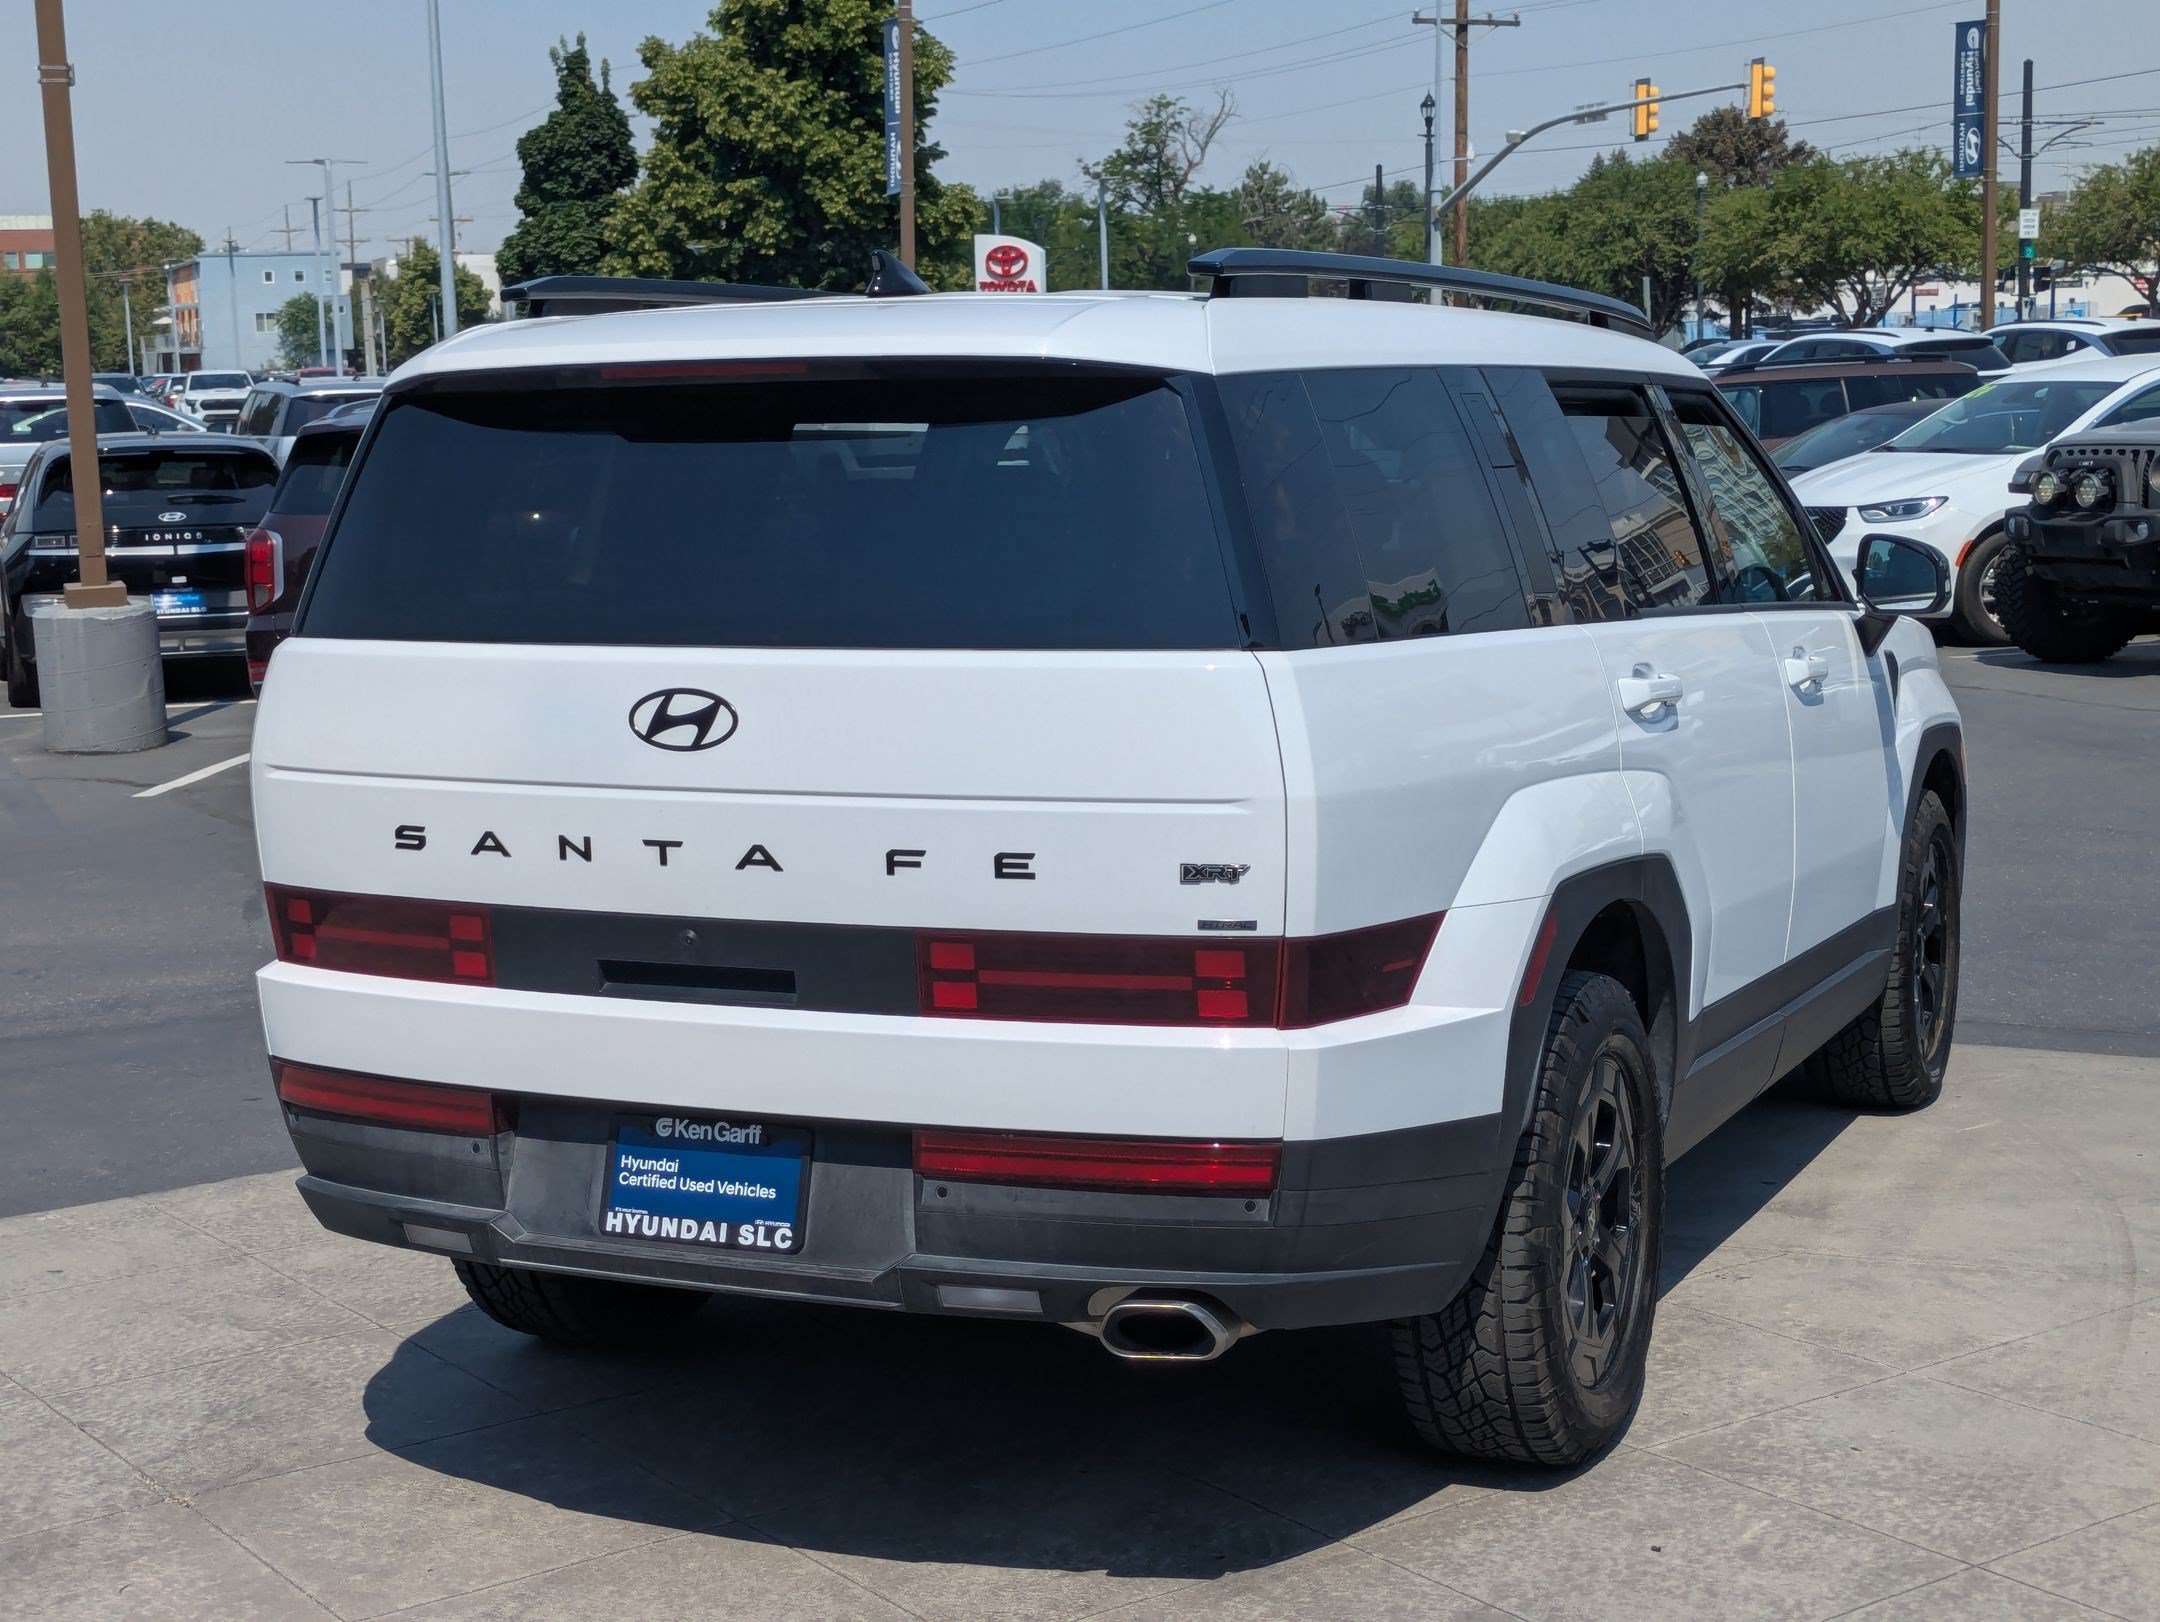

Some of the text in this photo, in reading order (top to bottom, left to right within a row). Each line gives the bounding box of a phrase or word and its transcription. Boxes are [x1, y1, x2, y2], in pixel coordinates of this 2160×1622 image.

[1965, 50, 1976, 107] Hyundai
[889, 131, 897, 188] HYUNDAI
[979, 280, 1037, 293] TOYOTA
[394, 824, 1036, 881] SANTA FE
[1180, 863, 1250, 885] XRT
[675, 1118, 763, 1145] Ken Garff
[620, 1154, 680, 1173] Hyundai
[618, 1171, 777, 1199] Certified Used Vehicles
[605, 1211, 793, 1249] HYUNDAI SLC
